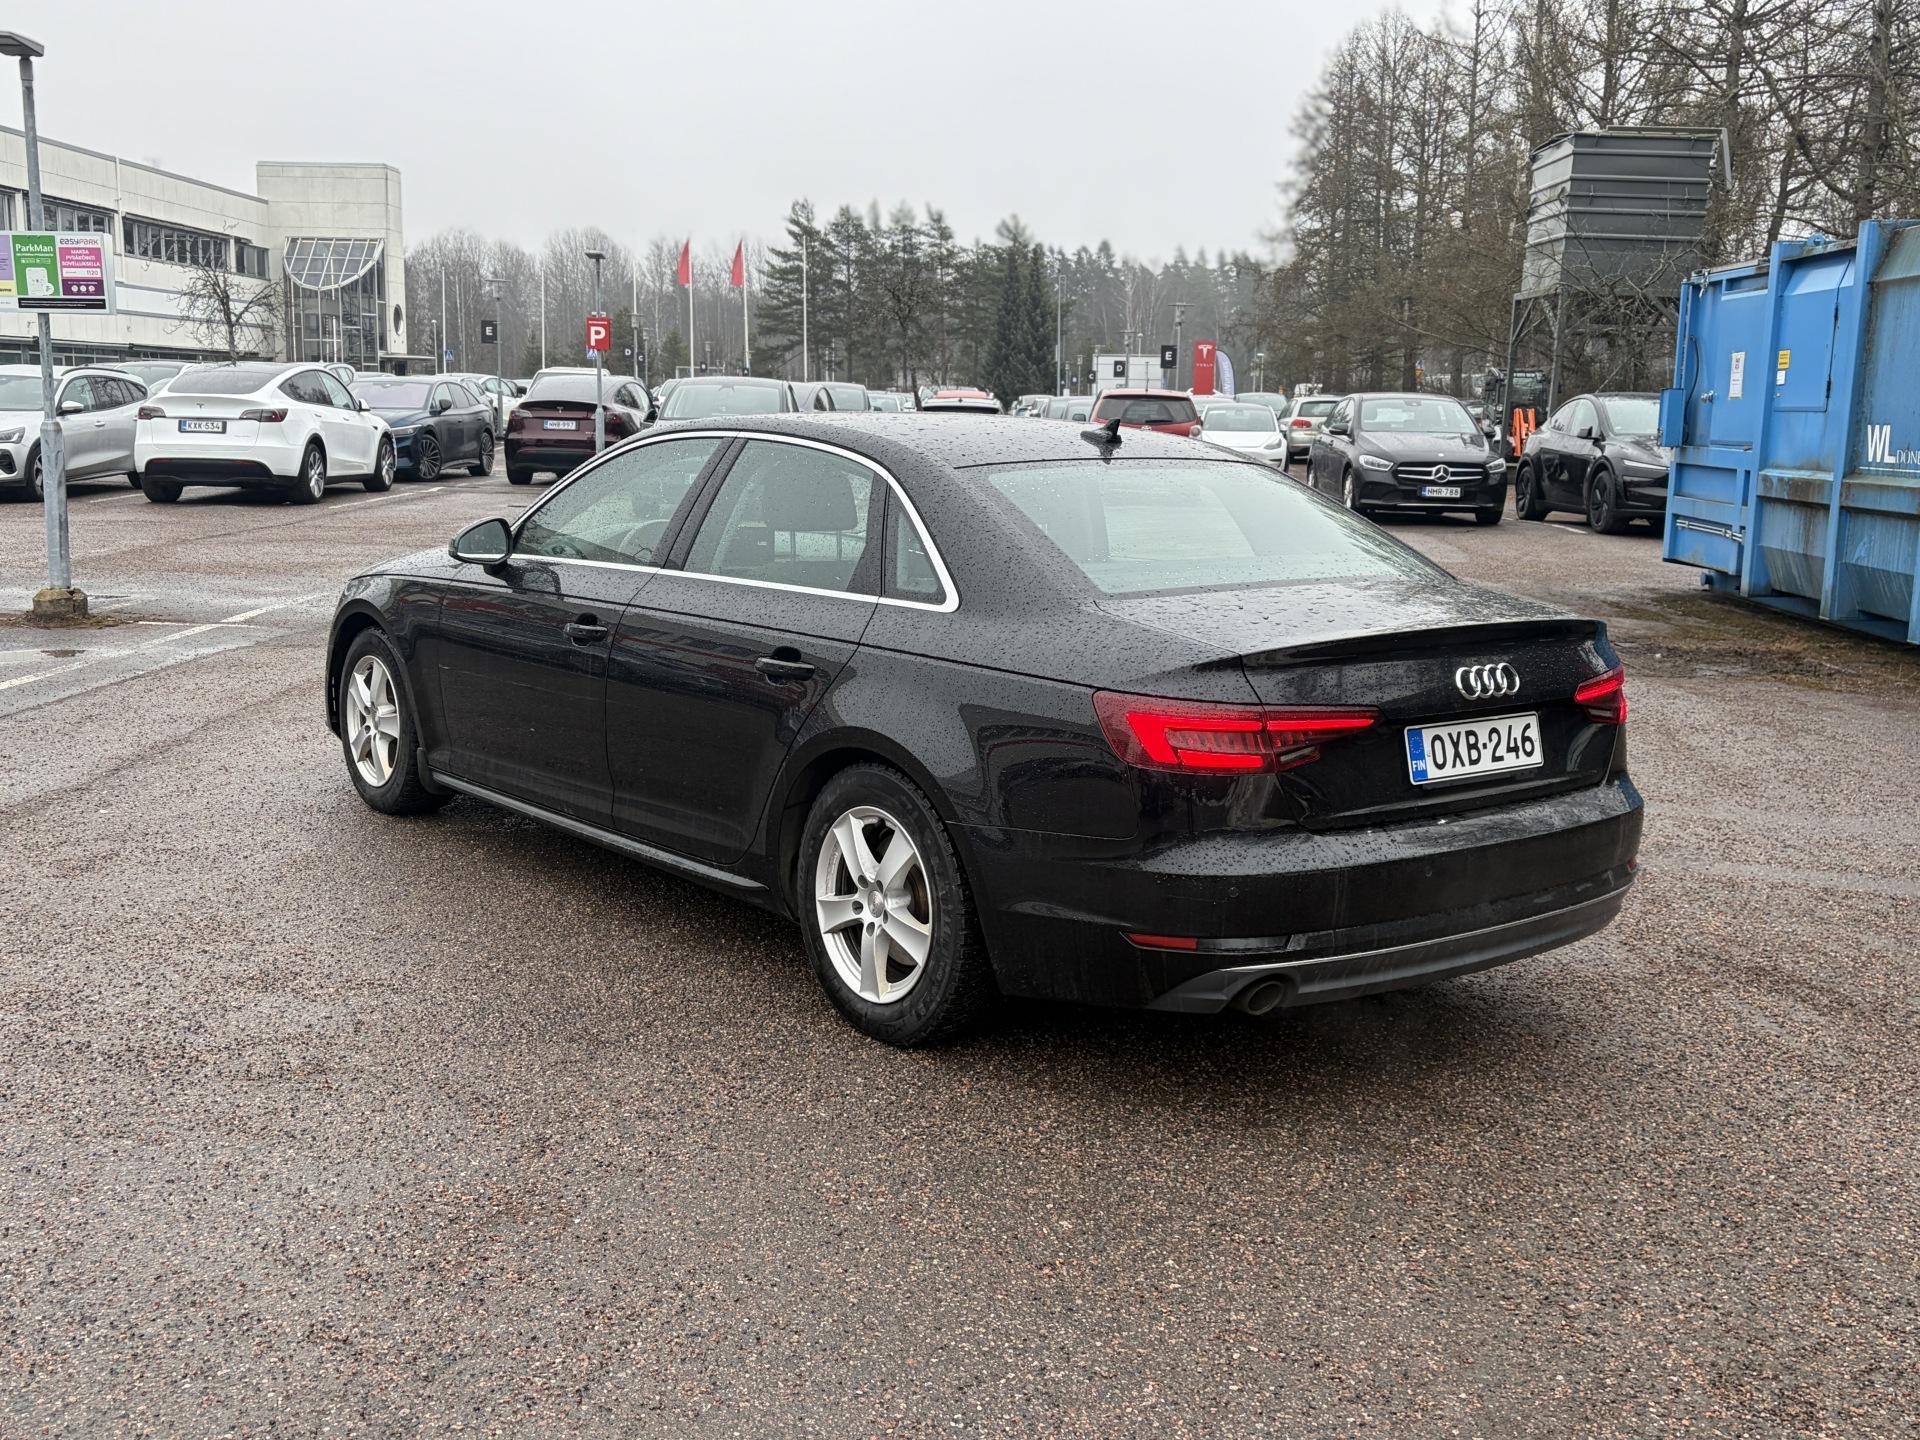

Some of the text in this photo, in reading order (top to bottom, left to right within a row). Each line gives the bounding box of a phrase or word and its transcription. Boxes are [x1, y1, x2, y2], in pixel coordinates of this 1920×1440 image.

[15, 243, 53, 252] ParkMan
[486, 326, 493, 335] E
[590, 326, 606, 346] P
[1165, 351, 1173, 360] E
[188, 422, 220, 430] KXK-534
[1867, 424, 1896, 463] WL
[1427, 488, 1459, 496] NMR-788
[1430, 722, 1535, 770] OXB-246
[1412, 760, 1426, 772] FIN
